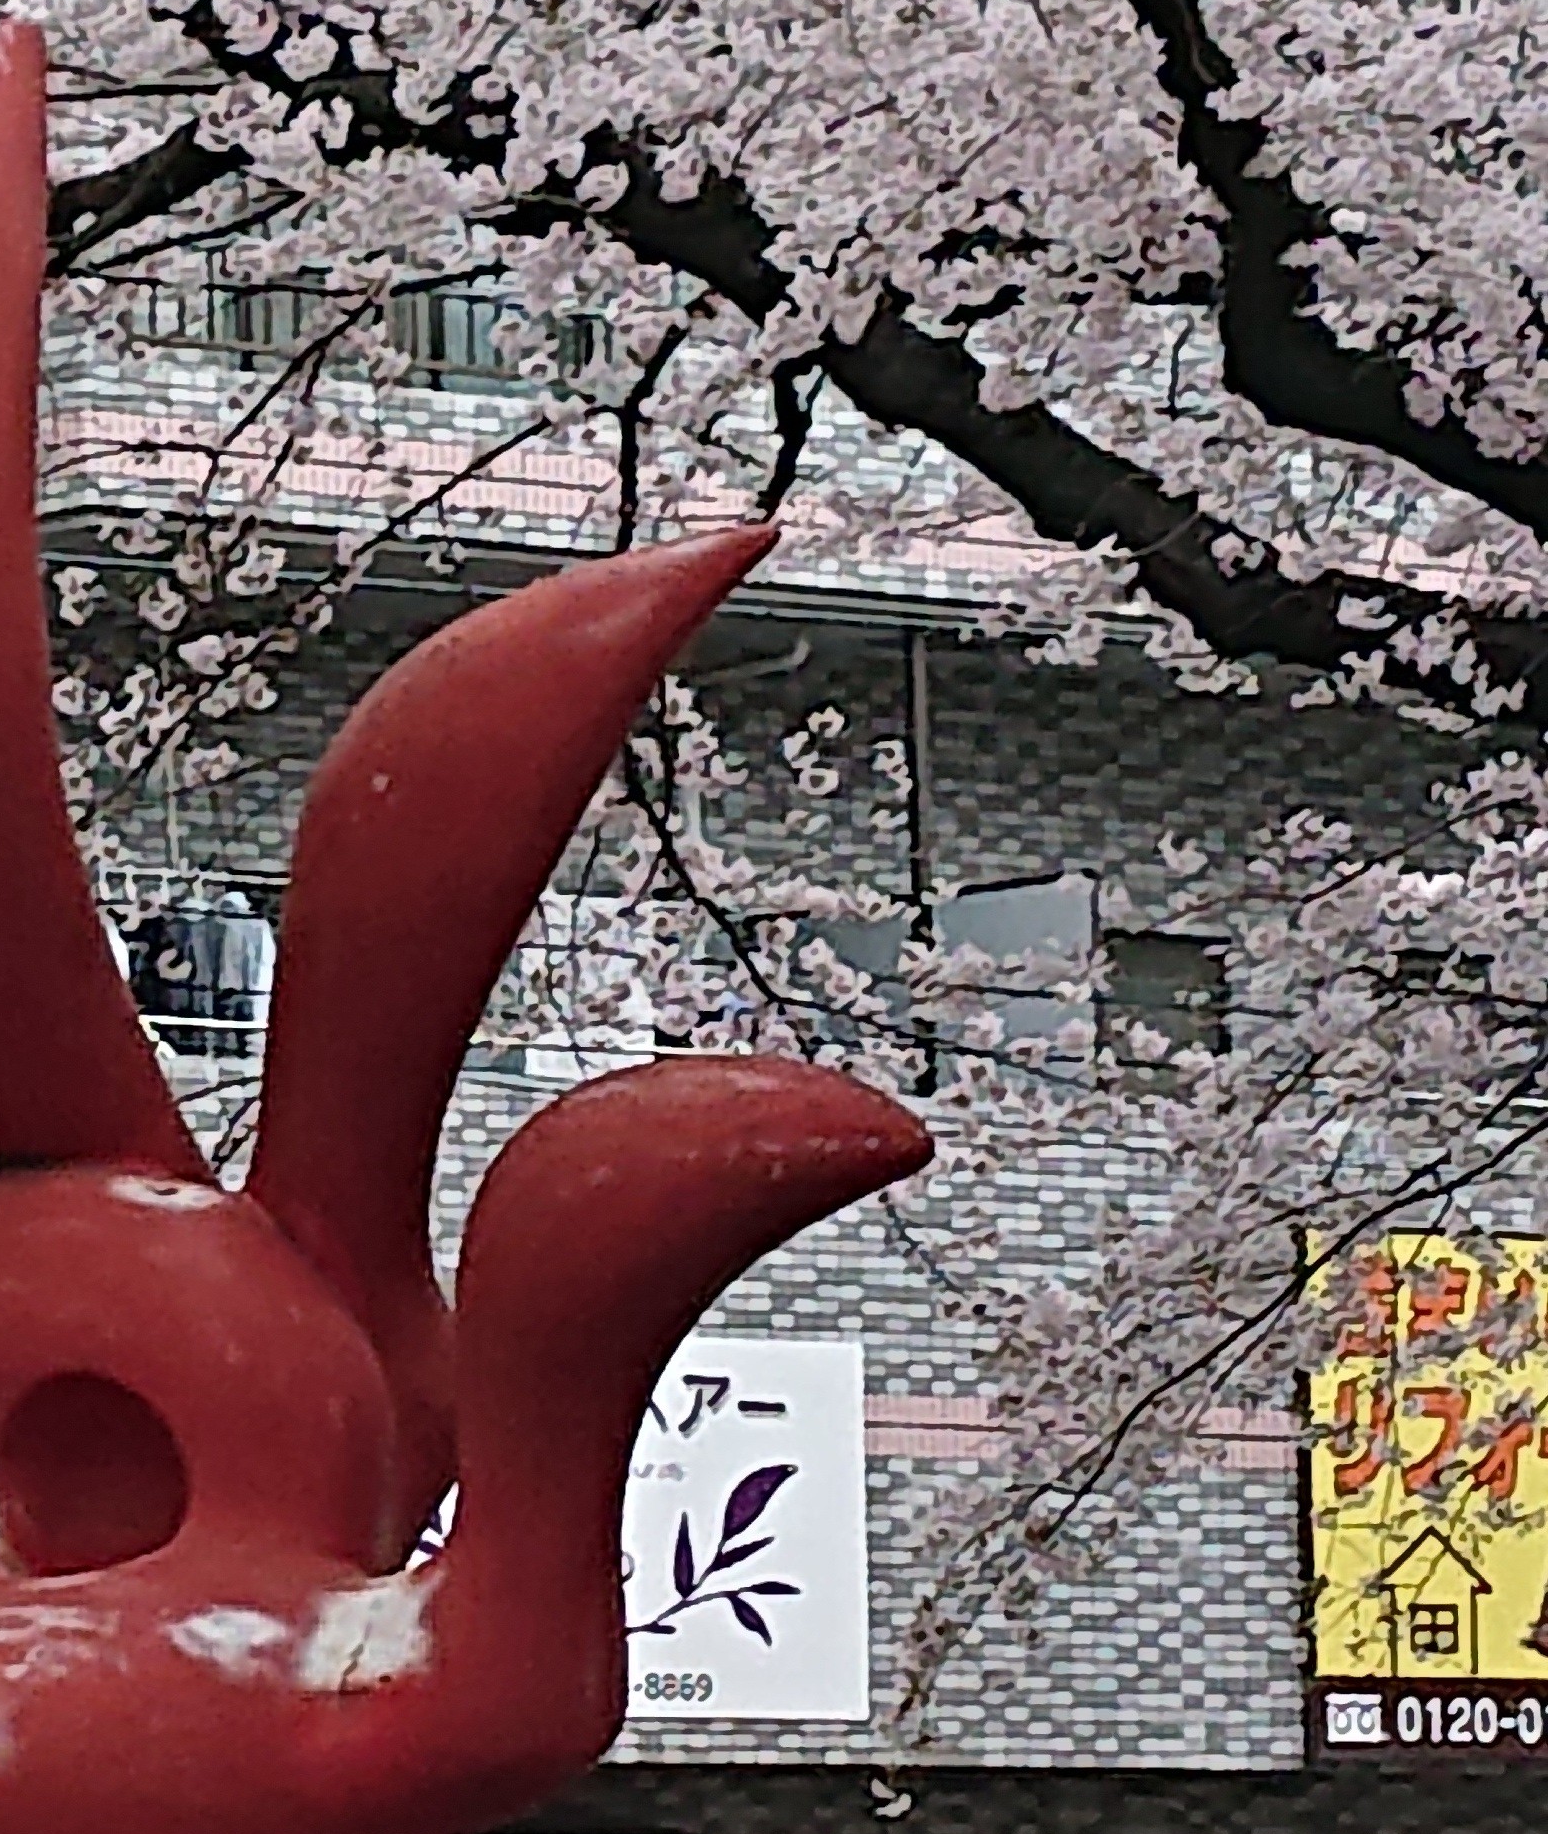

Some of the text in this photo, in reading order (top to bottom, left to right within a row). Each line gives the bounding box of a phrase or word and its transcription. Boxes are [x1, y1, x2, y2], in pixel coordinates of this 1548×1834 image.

[1333, 1381, 1548, 1502] リフォ
[1397, 1695, 1548, 1745] 0120-0
